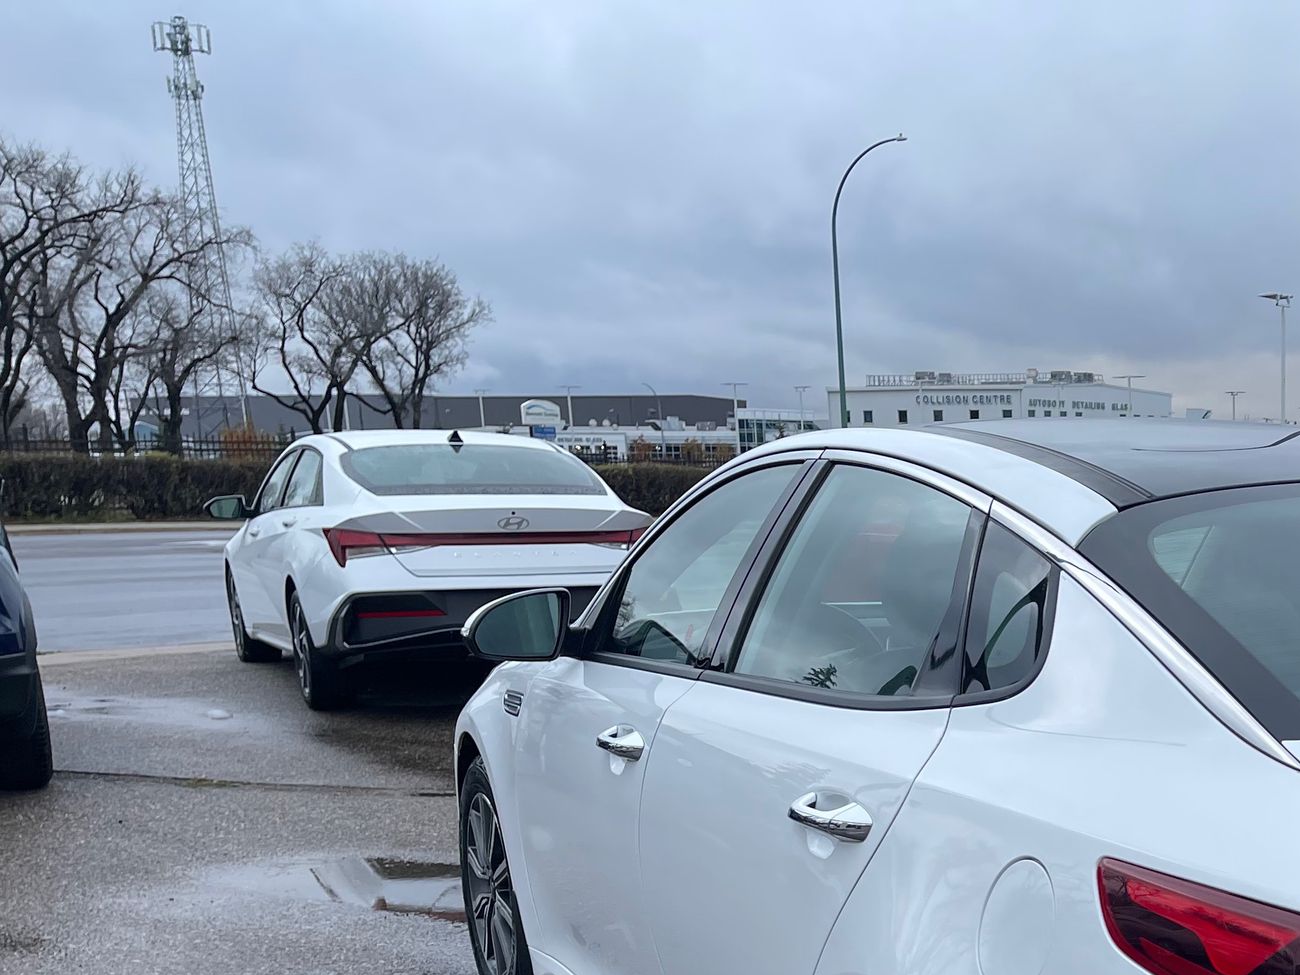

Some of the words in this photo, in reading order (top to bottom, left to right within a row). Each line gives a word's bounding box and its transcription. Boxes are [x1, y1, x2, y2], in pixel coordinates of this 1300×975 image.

[915, 394, 969, 405] COLLISION
[972, 394, 1012, 404] CENTRE
[1072, 400, 1106, 410] DETAILING
